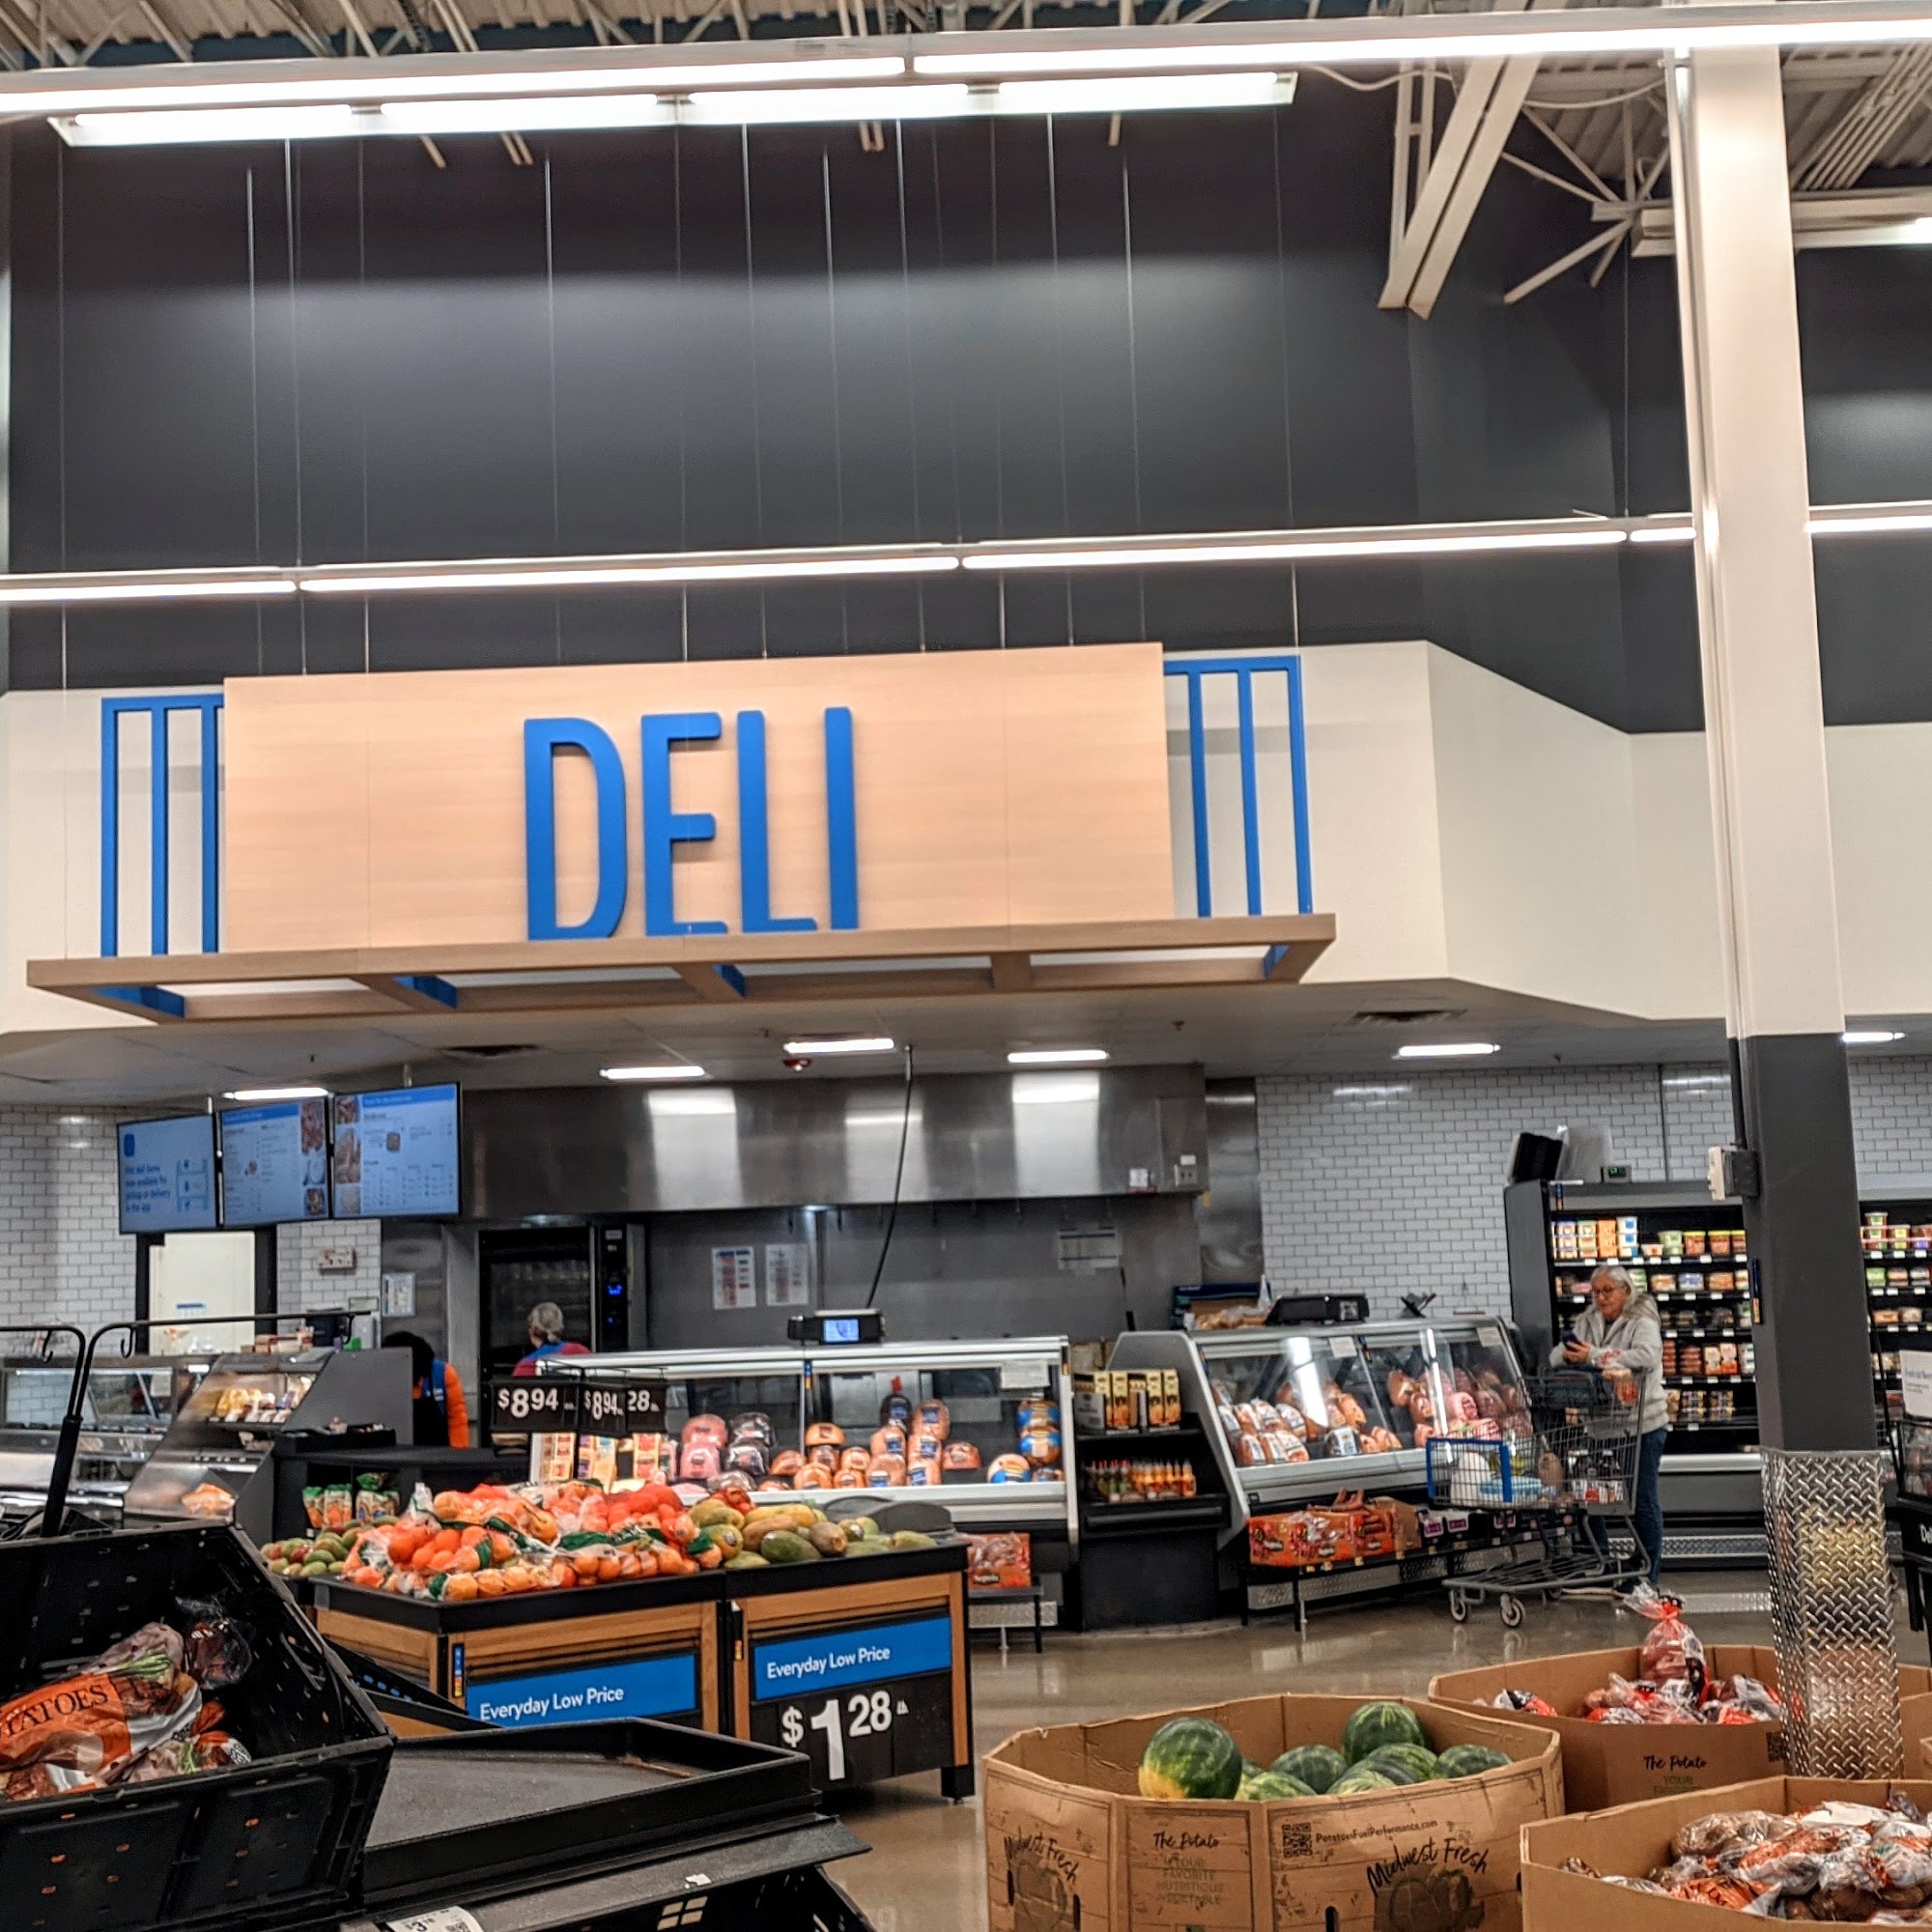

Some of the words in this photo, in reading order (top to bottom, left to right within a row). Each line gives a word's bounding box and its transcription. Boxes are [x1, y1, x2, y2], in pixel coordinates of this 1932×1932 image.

[524, 707, 859, 941] DELI
[767, 1656, 827, 1679] Everyday
[829, 1652, 856, 1669] Low
[858, 1646, 891, 1663] Price
[480, 1696, 550, 1721] Everyday
[553, 1692, 583, 1710] Low
[585, 1685, 624, 1705] Price
[1643, 1754, 1665, 1770] The
[1669, 1754, 1707, 1771] Potato
[1152, 1831, 1177, 1849] The
[1179, 1832, 1219, 1850] Potato
[1366, 1836, 1437, 1897] Midwest
[1443, 1837, 1489, 1875] Fresh
